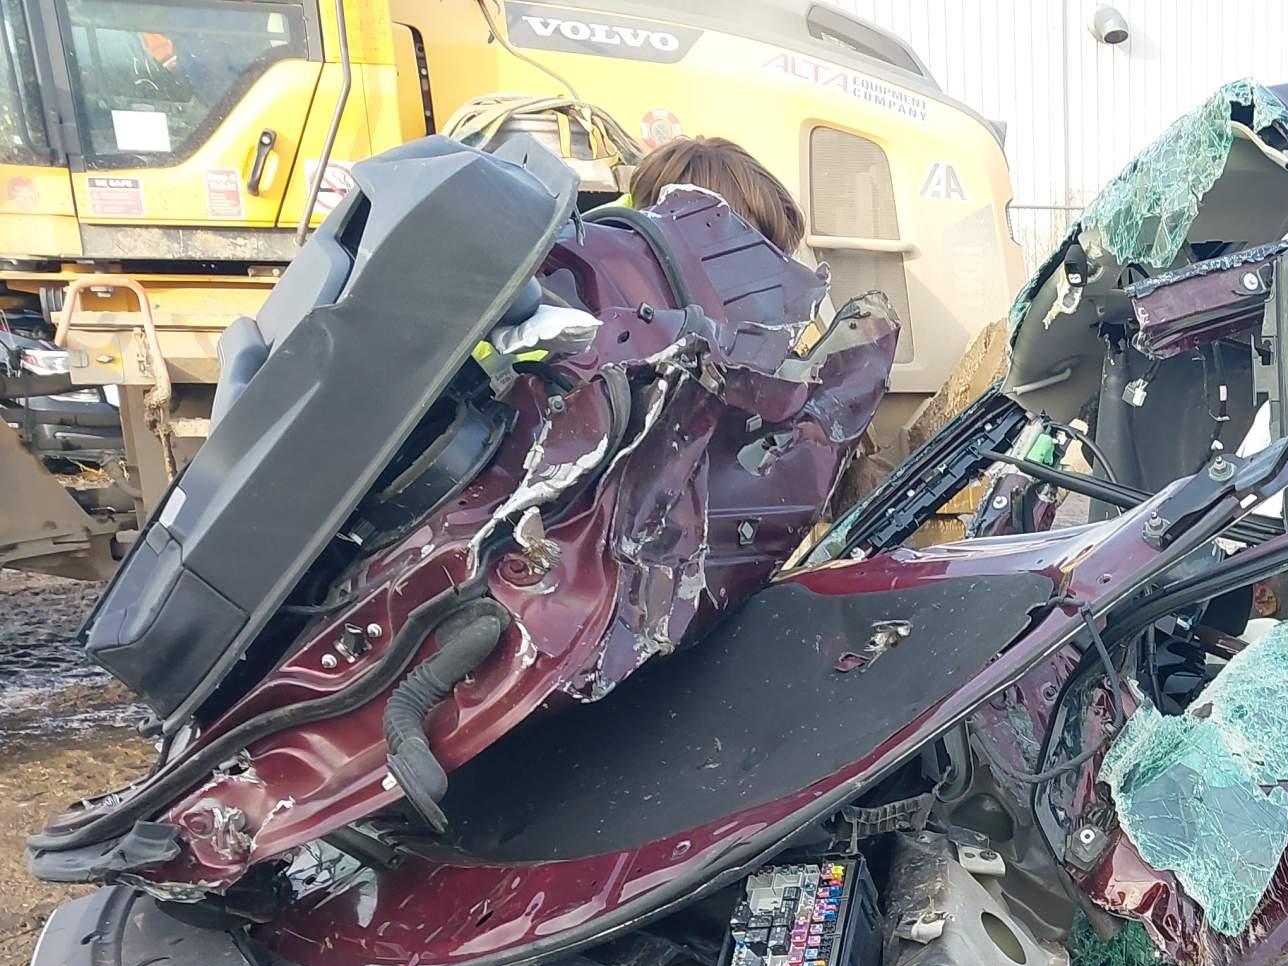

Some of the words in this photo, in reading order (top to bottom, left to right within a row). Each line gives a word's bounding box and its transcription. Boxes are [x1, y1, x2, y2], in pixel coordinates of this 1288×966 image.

[521, 15, 679, 51] VOLVO
[761, 53, 849, 94] ALTA
[852, 76, 927, 111] EQUIPMENT
[852, 87, 927, 121] COMPANY
